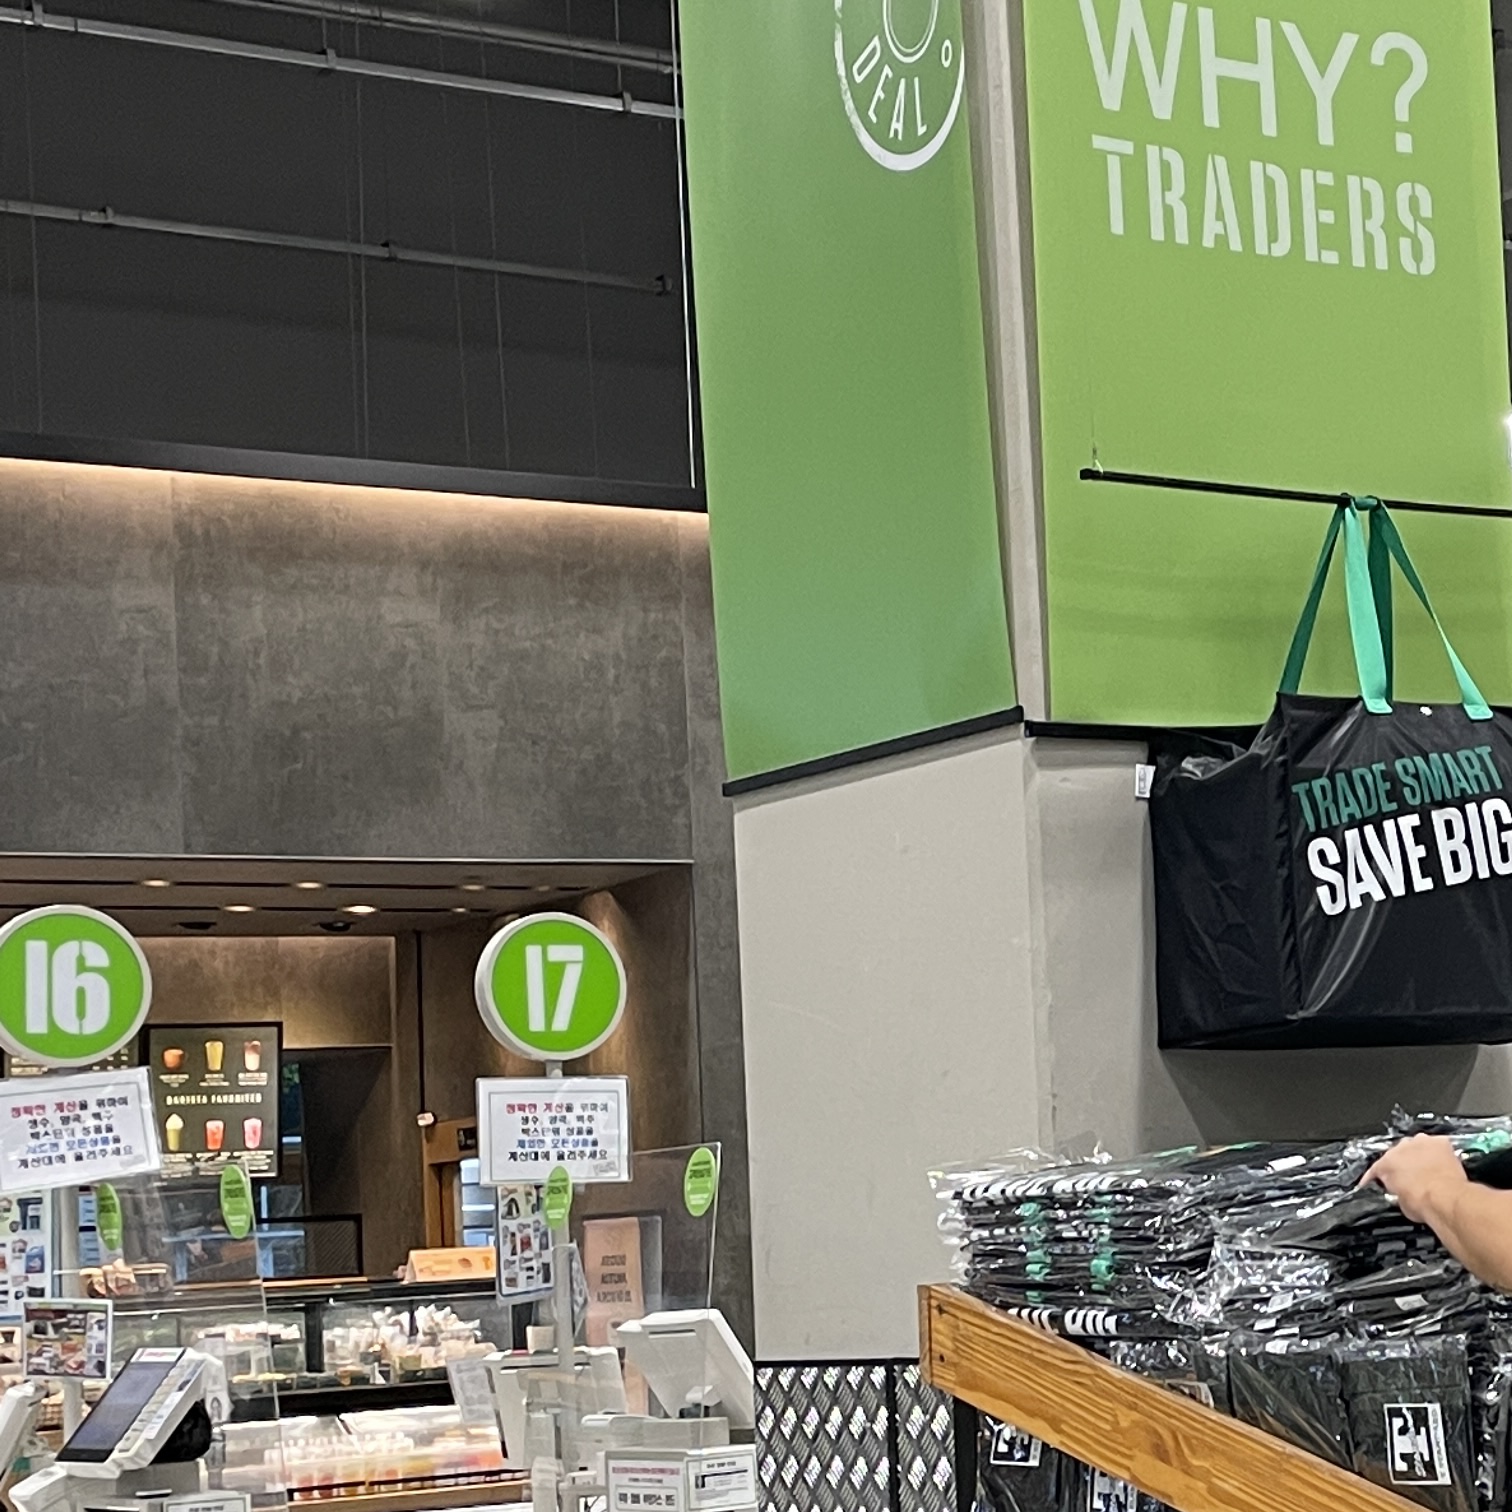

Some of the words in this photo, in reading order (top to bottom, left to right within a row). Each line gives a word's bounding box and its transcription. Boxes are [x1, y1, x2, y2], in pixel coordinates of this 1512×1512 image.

[852, 34, 927, 141] DEAL
[1078, 0, 1429, 154] WHY?
[1091, 134, 1436, 276] TRADERS
[1292, 761, 1399, 833] TRADE
[1394, 745, 1503, 806] SMART
[1306, 813, 1435, 916] SAVE
[25, 939, 111, 1036] 16
[525, 943, 584, 1033] 17
